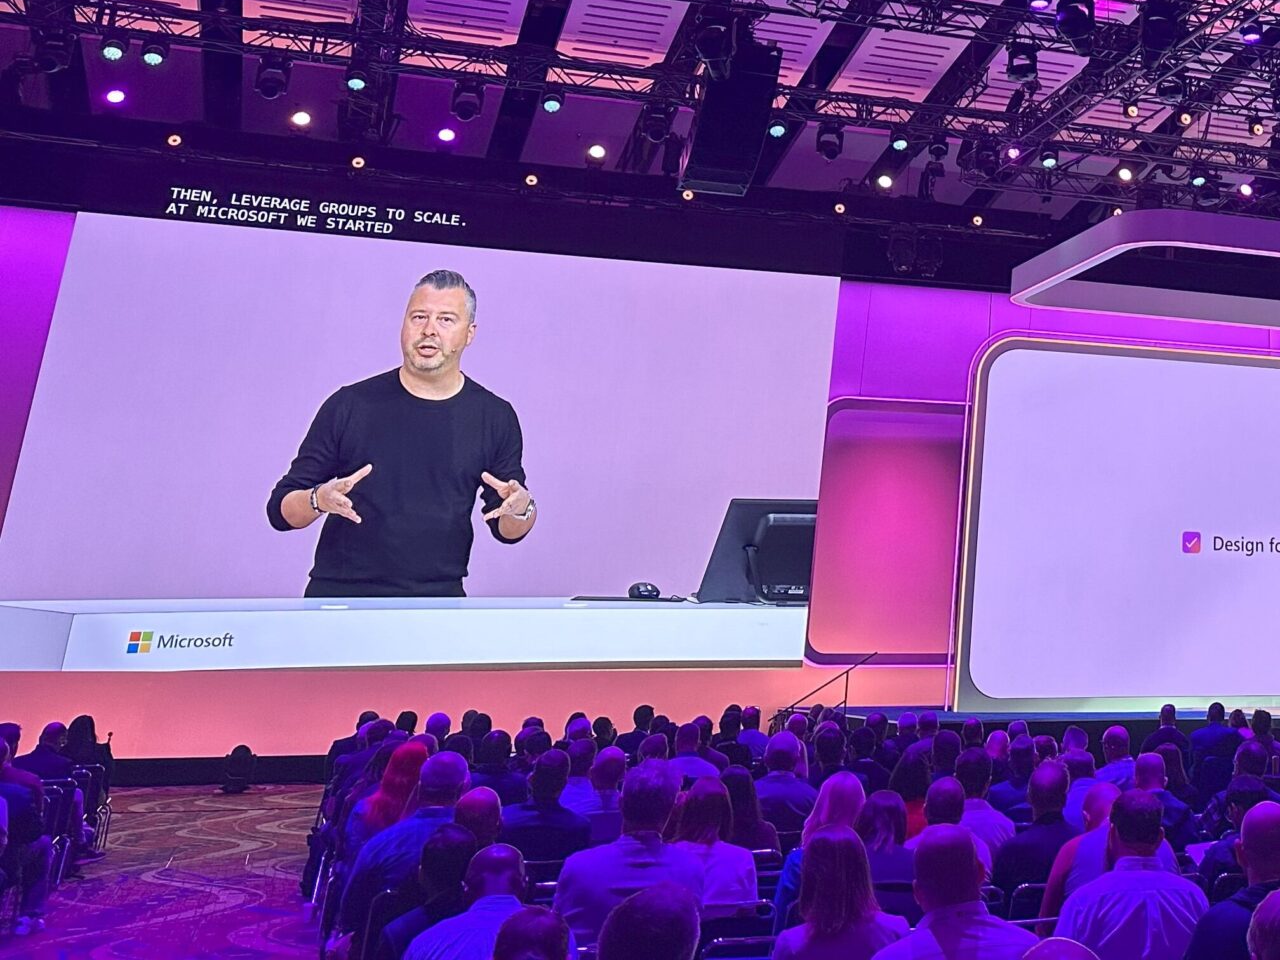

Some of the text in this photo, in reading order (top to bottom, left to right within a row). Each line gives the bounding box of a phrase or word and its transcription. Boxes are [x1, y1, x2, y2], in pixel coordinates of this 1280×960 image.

[166, 203, 393, 234] AT MICROSOFT WE STARTED
[170, 187, 467, 226] THEN, LEVERAGE GROUPS TO SCALE.
[1213, 536, 1264, 556] Design
[157, 633, 234, 649] Microsoft
